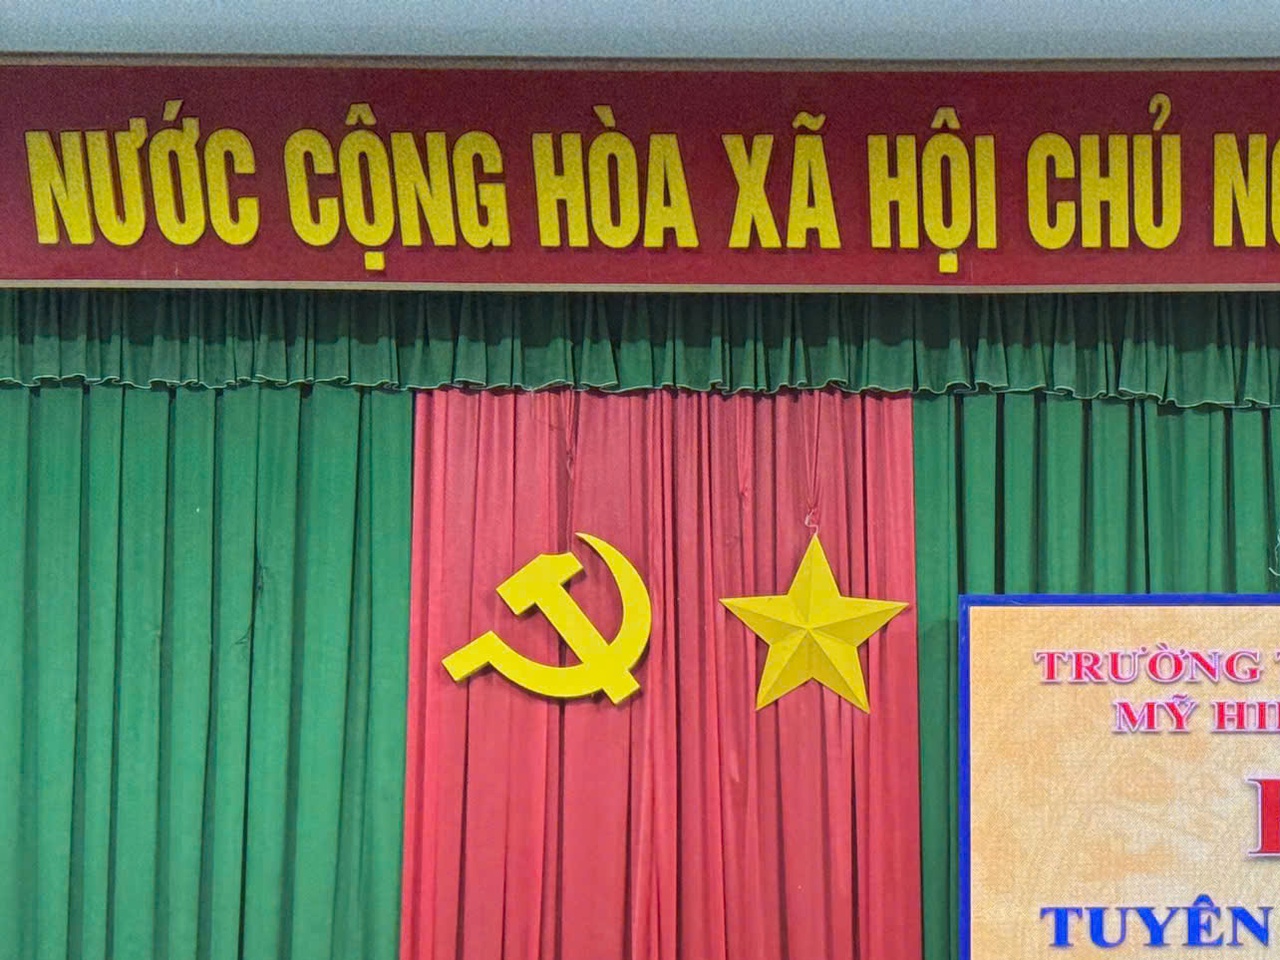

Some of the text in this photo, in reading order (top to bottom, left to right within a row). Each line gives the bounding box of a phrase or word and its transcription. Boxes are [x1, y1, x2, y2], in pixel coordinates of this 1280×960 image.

[26, 101, 259, 246] NƯỚC
[284, 103, 511, 271] CỘNG
[532, 105, 699, 249] HÒA
[722, 112, 841, 249] XÃ
[868, 107, 997, 273] HỘI
[1027, 93, 1182, 249] CHỦ
[1035, 643, 1261, 683] TRƯỜNG
[1112, 694, 1198, 733] MỸ
[1040, 894, 1270, 948] TUYÊN
